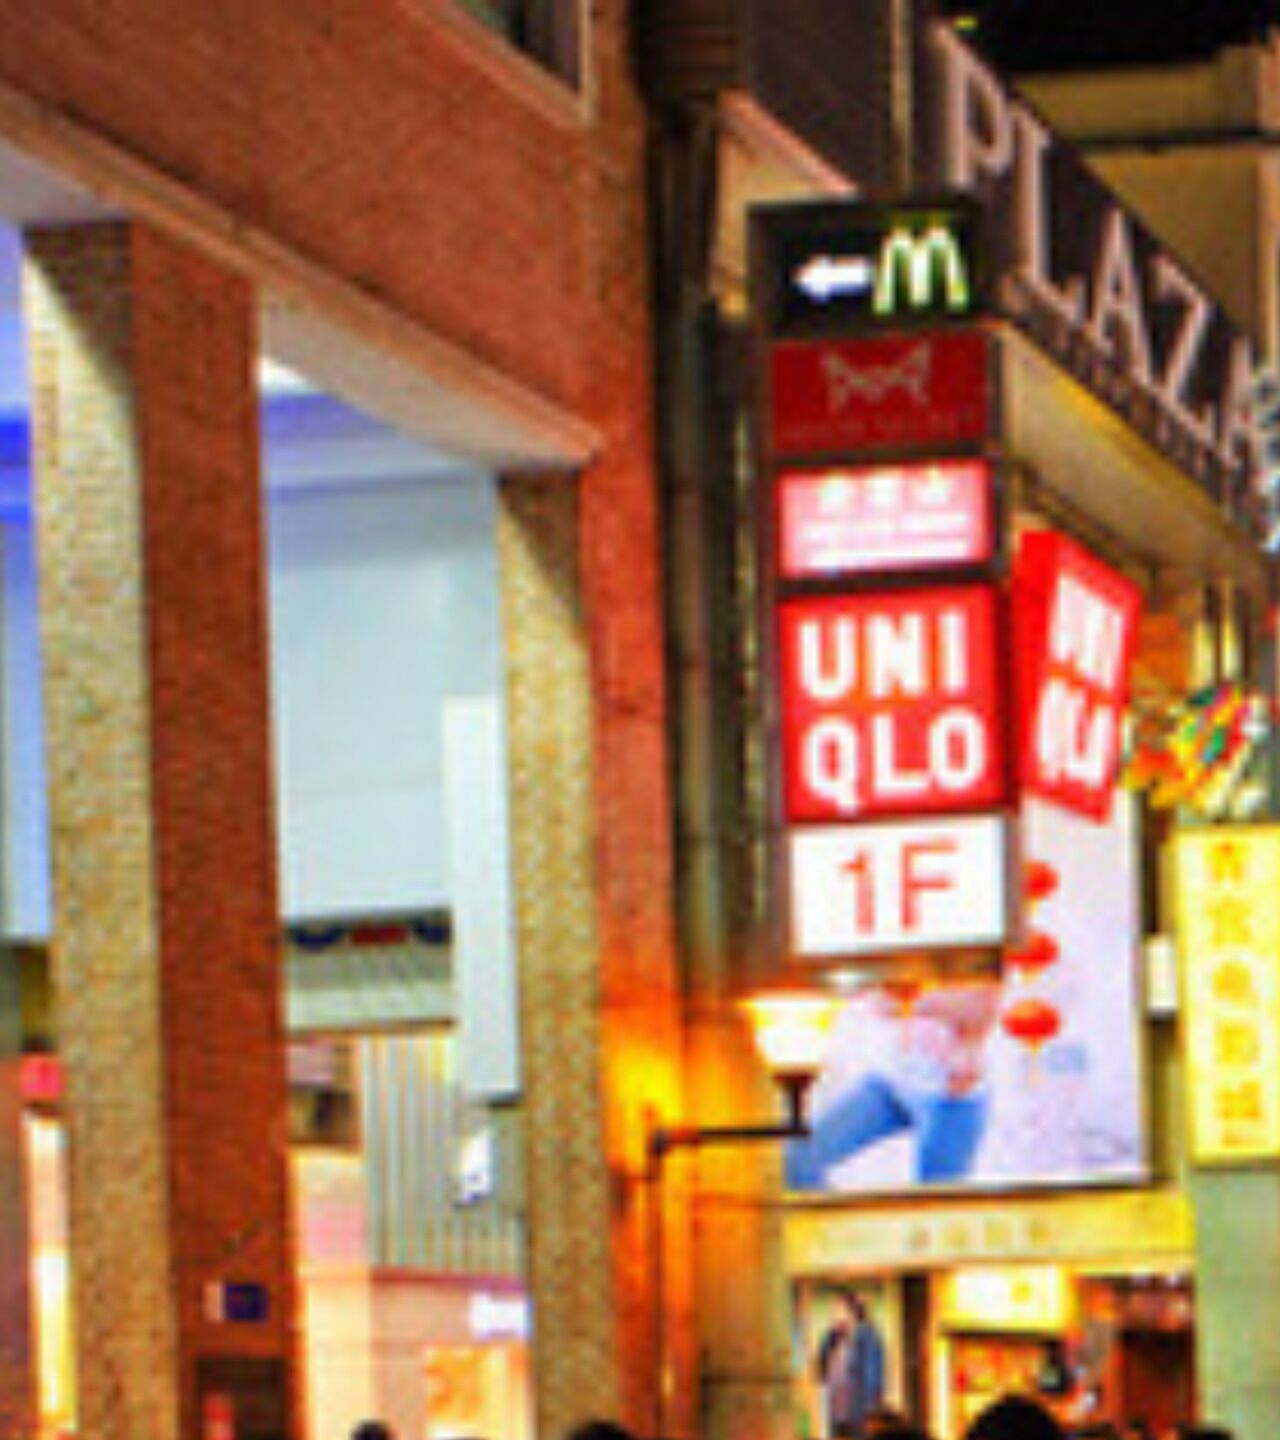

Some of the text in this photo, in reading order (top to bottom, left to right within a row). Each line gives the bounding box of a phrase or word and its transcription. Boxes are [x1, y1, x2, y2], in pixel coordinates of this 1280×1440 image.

[932, 22, 1268, 518] PLAZA
[799, 608, 966, 699] UNI
[803, 708, 987, 814] QLO
[841, 839, 957, 933] 1F
